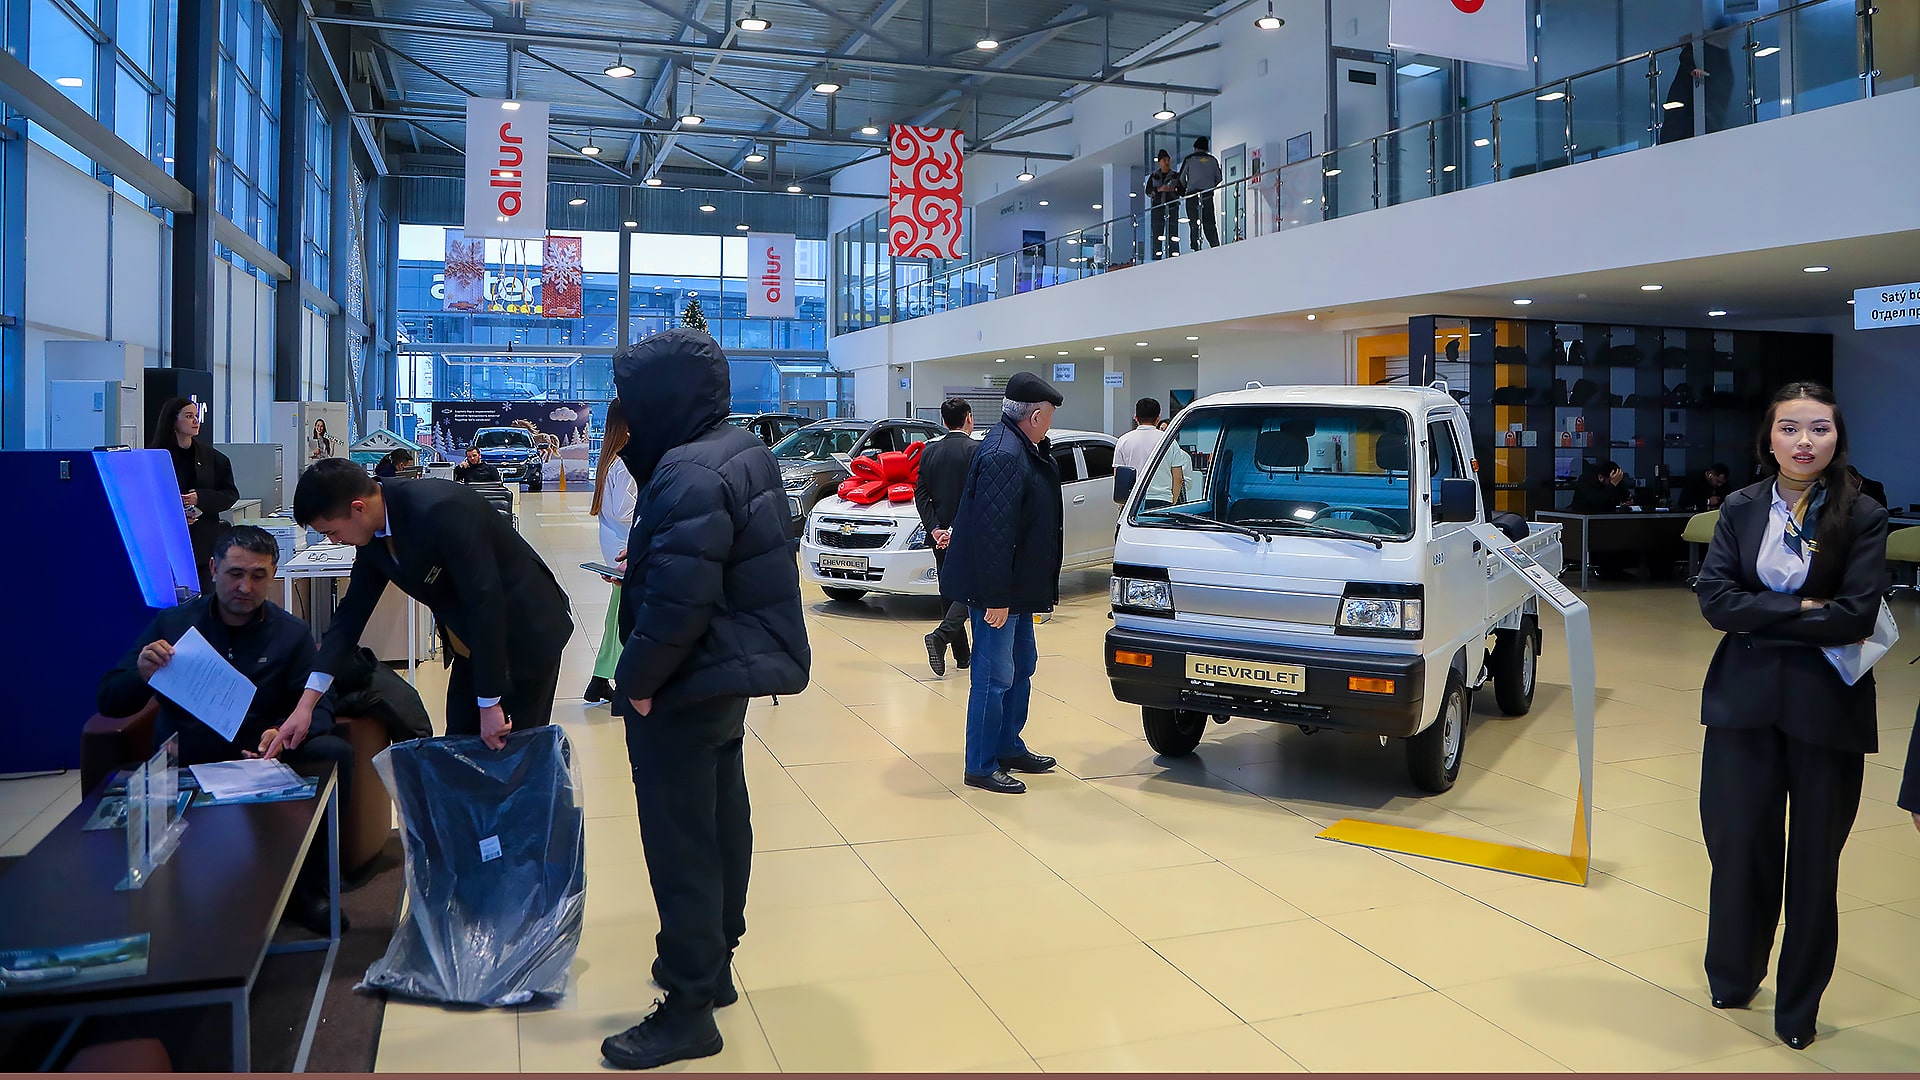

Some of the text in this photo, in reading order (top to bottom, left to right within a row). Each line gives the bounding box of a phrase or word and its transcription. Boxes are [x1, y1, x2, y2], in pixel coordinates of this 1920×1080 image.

[489, 122, 523, 217] allur
[761, 246, 781, 303] allur
[1871, 308, 1906, 321] Отдел
[822, 559, 865, 568] CHEVROLET
[1194, 662, 1300, 685] CHEVROLET
